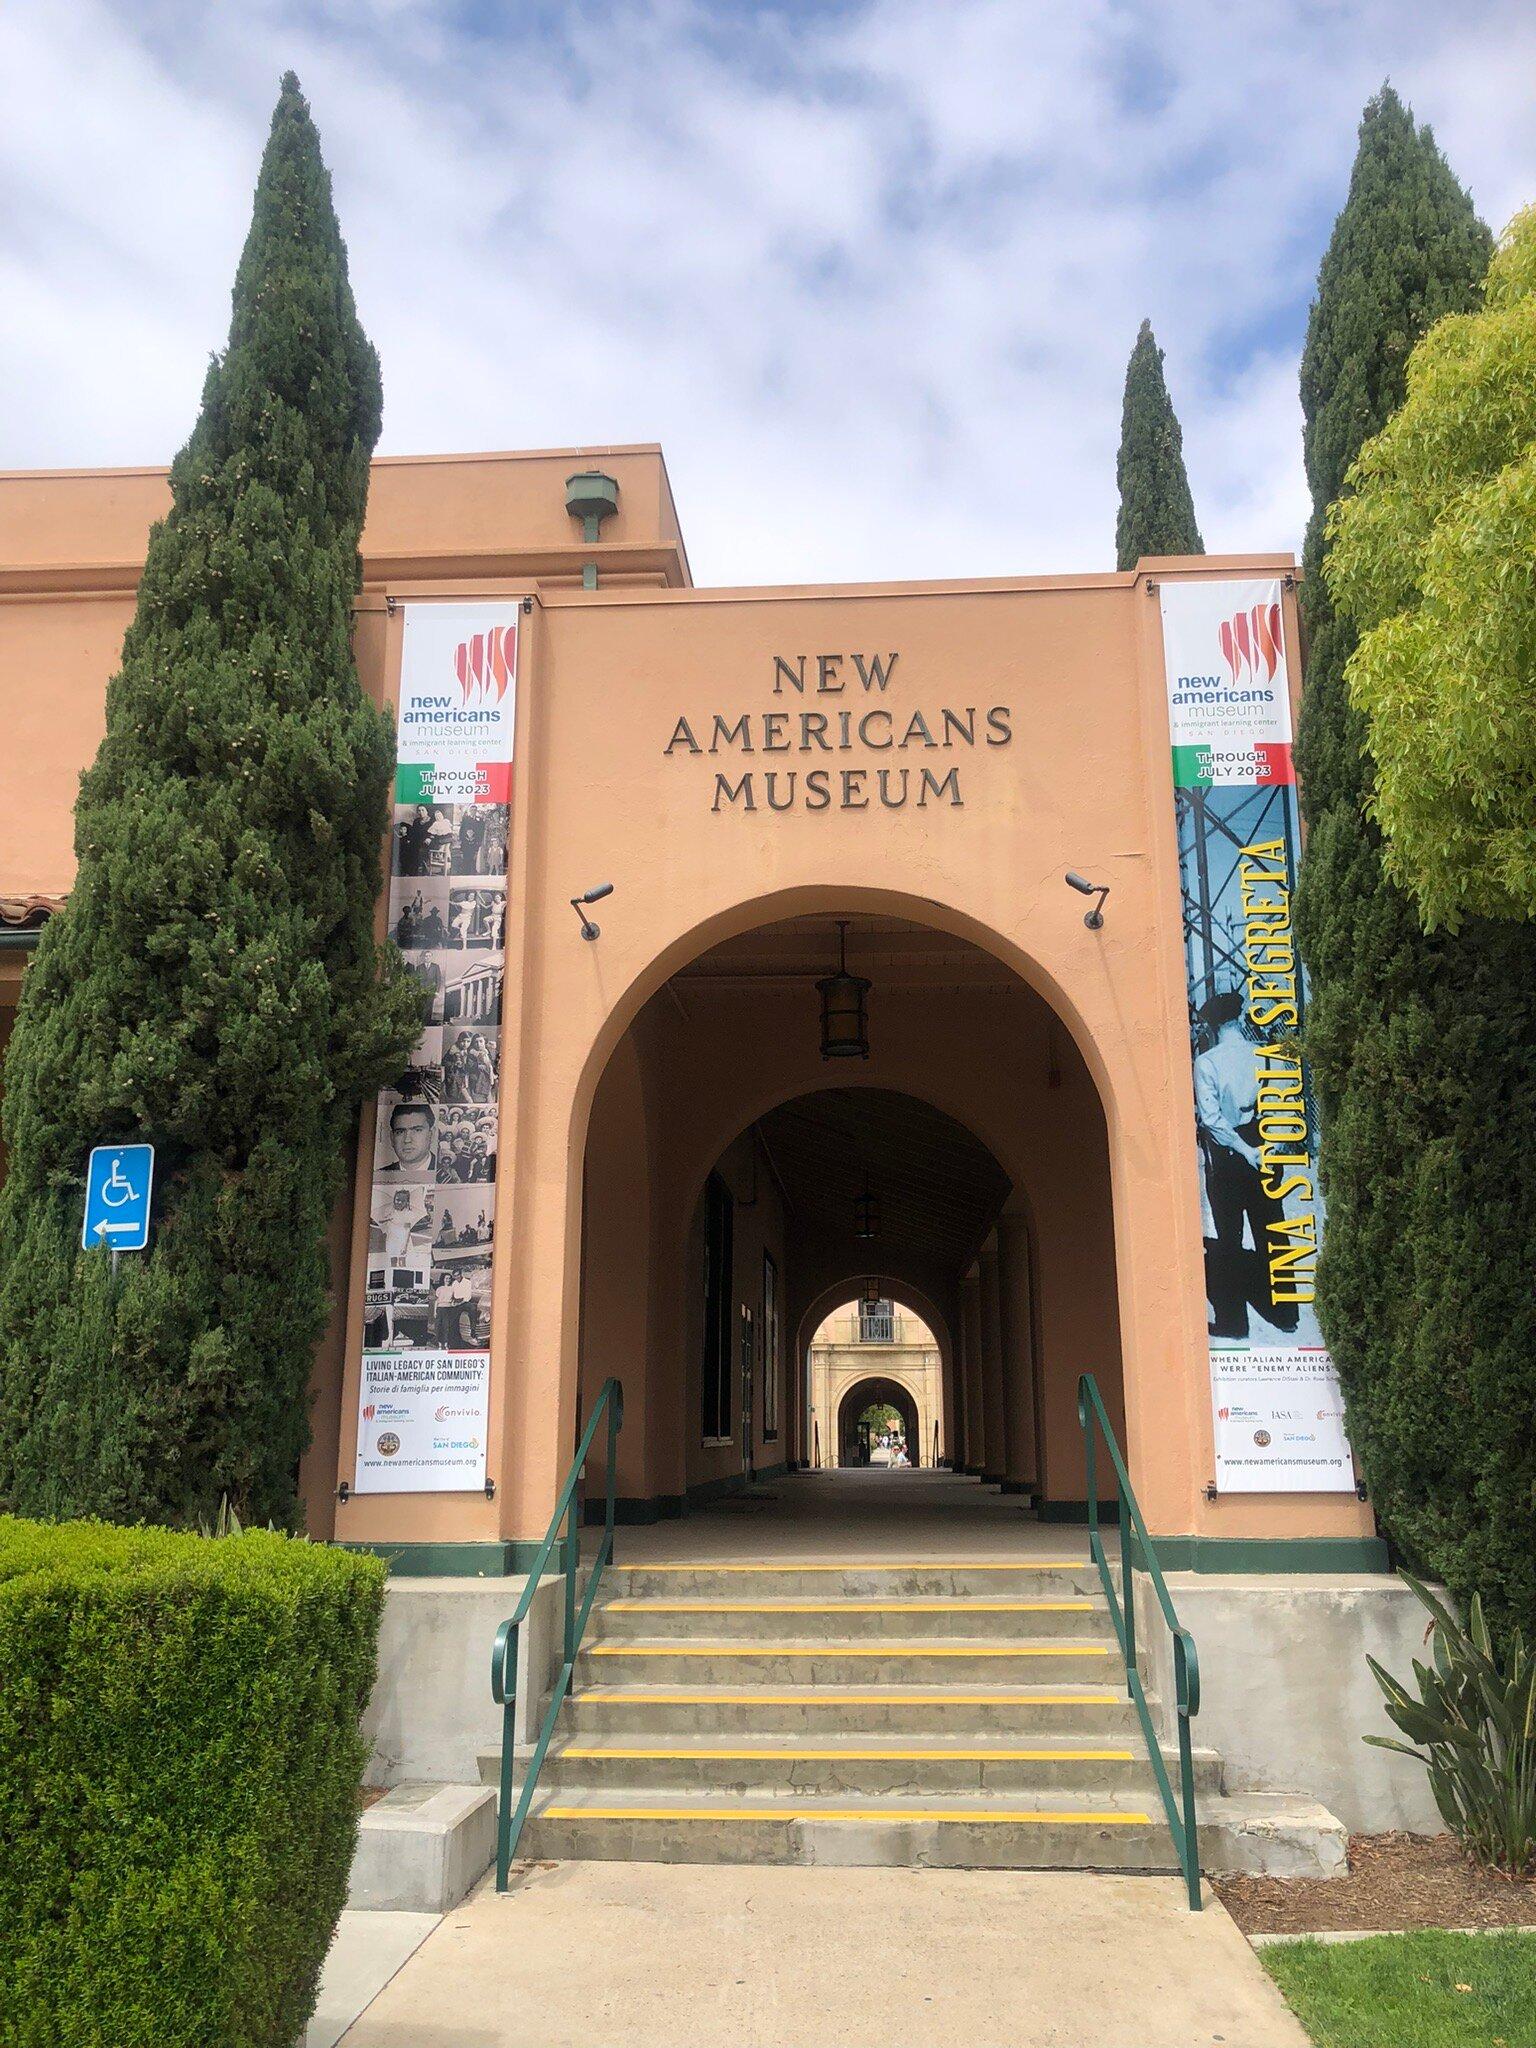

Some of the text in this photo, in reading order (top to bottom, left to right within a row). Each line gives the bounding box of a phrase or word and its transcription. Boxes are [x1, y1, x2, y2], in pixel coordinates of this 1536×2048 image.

[772, 652, 899, 694] NEW
[1178, 675, 1221, 688] new
[411, 696, 451, 708] new
[1172, 687, 1274, 705] americans
[404, 708, 500, 723] americans
[1188, 705, 1264, 717] museum
[418, 724, 489, 736] museum
[663, 706, 1012, 755] AMERICANS
[1181, 721, 1219, 729] immigrant
[1197, 752, 1265, 763] THROUGH
[420, 771, 486, 782] THROUGH
[1198, 766, 1271, 777] JULY 2023
[420, 784, 490, 795] JULY 2023
[711, 767, 964, 812] MUSEUM
[1239, 838, 1318, 1306] UNA STORIA SEGRETA
[366, 1359, 485, 1371] LIVING LEGACY OF SAN DIEGO'S
[366, 1370, 483, 1382] ITALIAN-AMERICAN COMMUNITY:
[369, 1384, 479, 1395] Storie di famiglia per immagini
[364, 1458, 477, 1468] www.newamericansmuseum.org
[1224, 1457, 1342, 1468] www.newamericansmuseum.org
